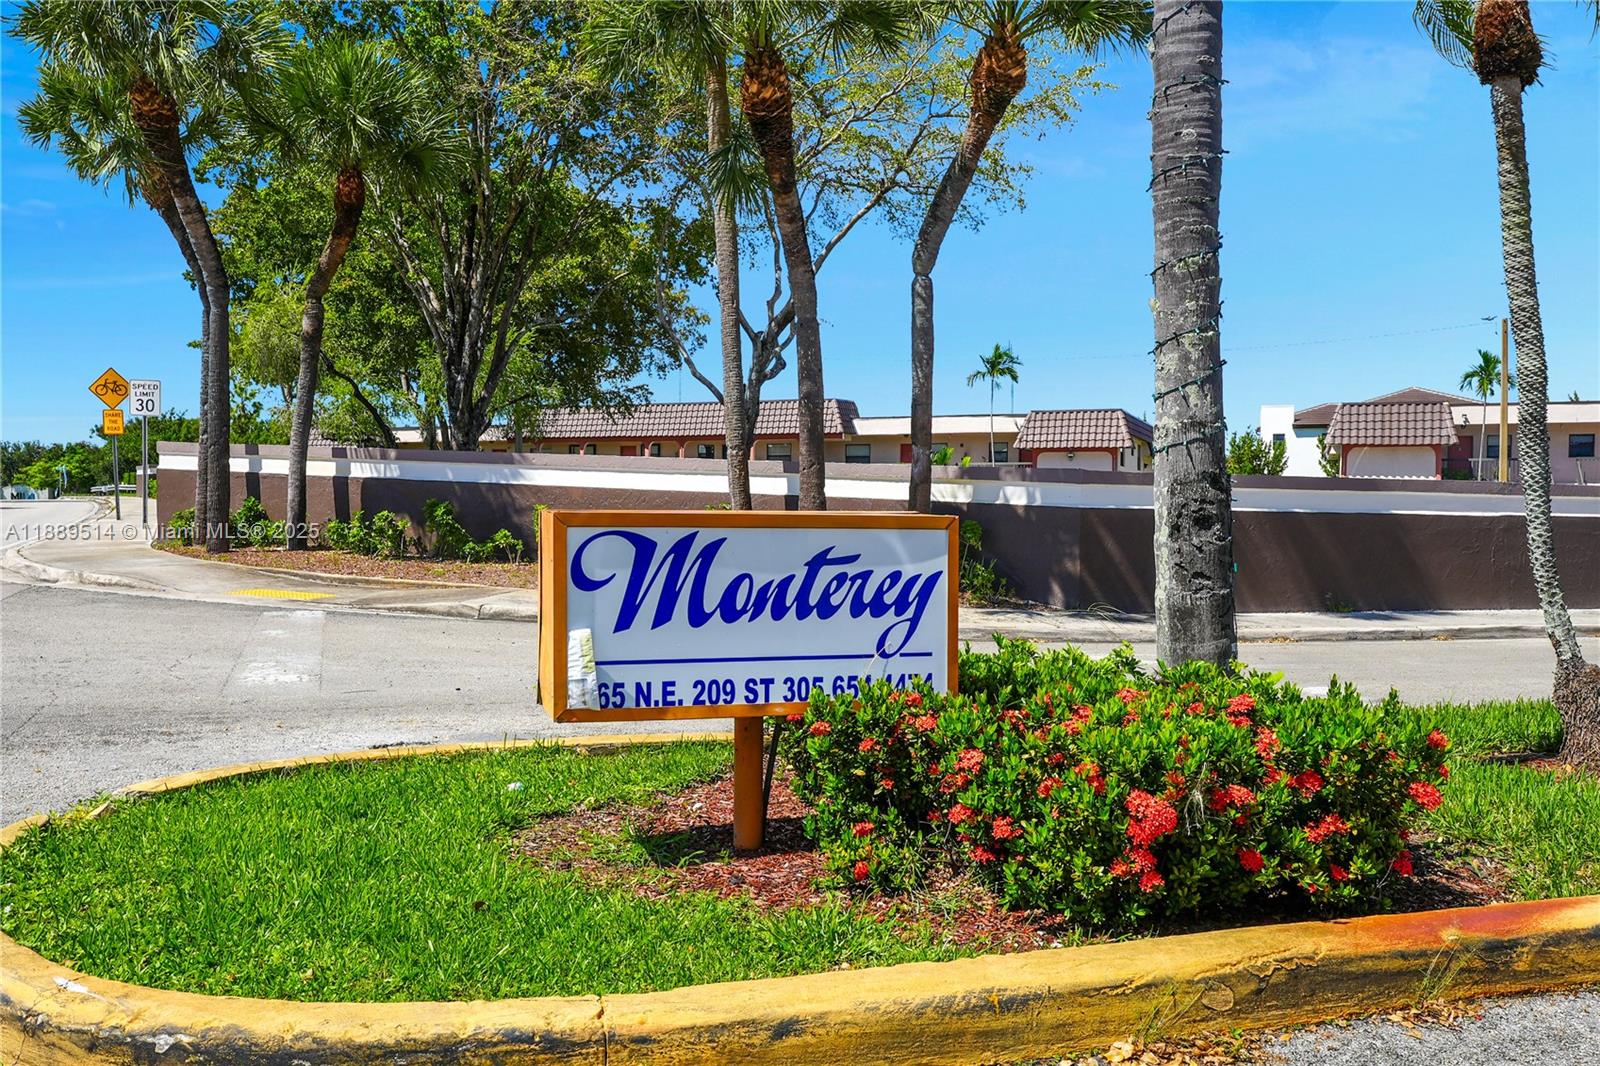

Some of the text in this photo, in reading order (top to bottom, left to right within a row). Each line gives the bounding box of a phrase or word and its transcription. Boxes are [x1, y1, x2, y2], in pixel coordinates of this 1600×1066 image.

[135, 399, 155, 412] 30
[570, 530, 943, 659] Monterey
[634, 681, 684, 707] N.E.
[692, 679, 736, 705] 209
[743, 678, 775, 703] ST
